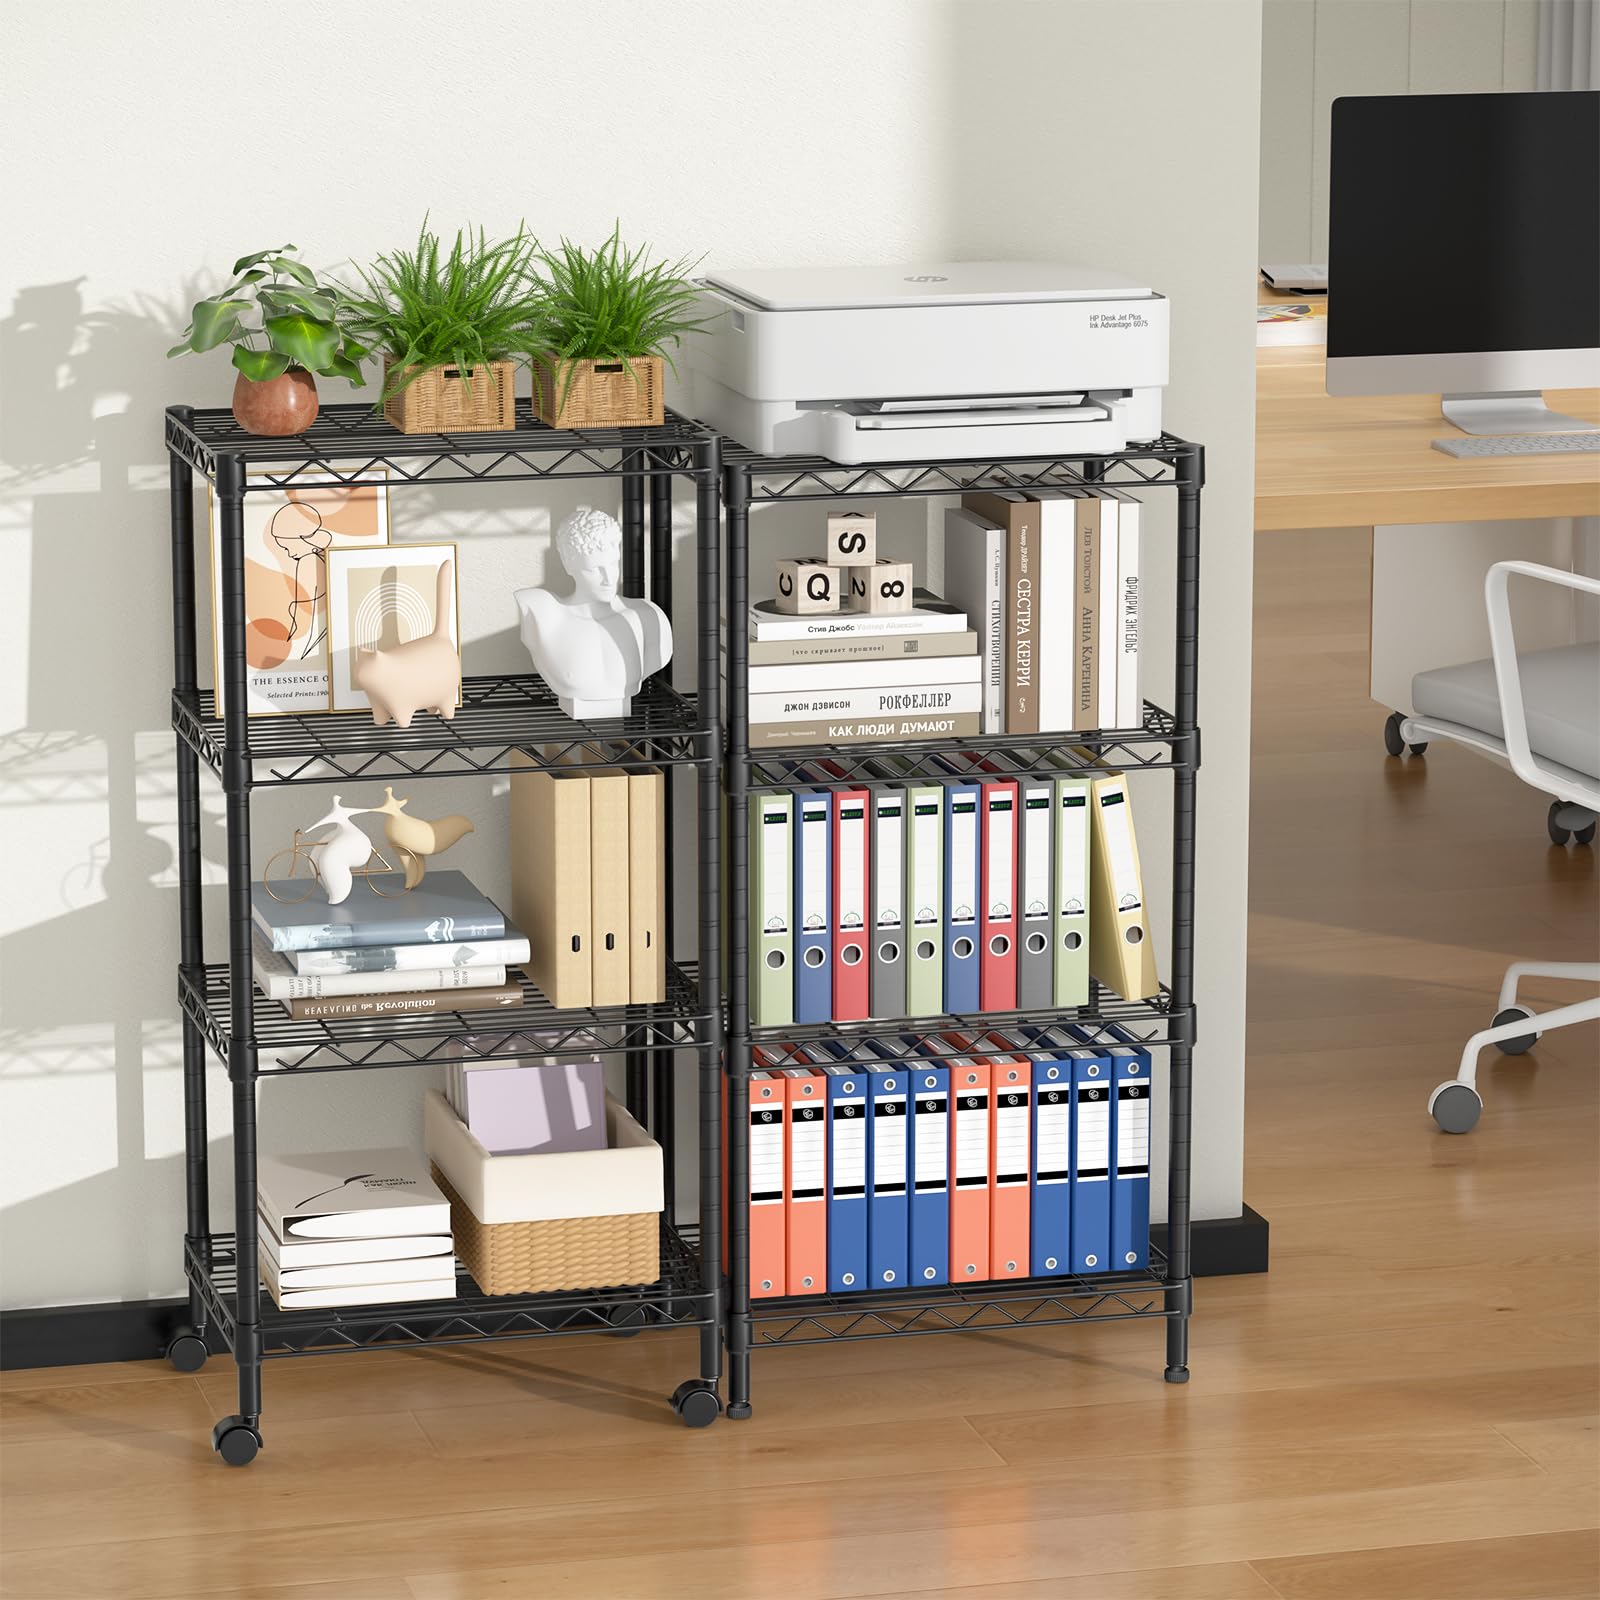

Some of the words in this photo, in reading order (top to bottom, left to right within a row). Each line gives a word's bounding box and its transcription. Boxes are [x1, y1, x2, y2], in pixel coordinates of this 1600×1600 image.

[1100, 321, 1131, 329] Advantage
[1133, 319, 1149, 327] 6075
[838, 532, 866, 554] S
[1084, 527, 1093, 546] ЛЕВ
[806, 572, 831, 602] Q
[880, 580, 905, 599] 8
[1125, 576, 1139, 616] ФРИДРИХ
[1017, 578, 1032, 635] СЕСТРА
[807, 625, 827, 633] Стив
[828, 624, 855, 633] Джобс
[1082, 607, 1093, 644] АННА
[1124, 618, 1138, 654] ЭНГЕЛЬС
[991, 600, 1001, 686] СТИХОТВОРЕНИЯ
[1017, 639, 1032, 687] КЕРРИ
[253, 677, 273, 686] THE
[276, 675, 319, 685] ESSENCE
[267, 691, 293, 699] Selected
[784, 702, 809, 712] ДЖОН
[812, 700, 851, 711] ДЭВИСОН
[879, 692, 952, 710] РОКФЕЛЛЕР
[828, 724, 853, 737] КАК
[856, 722, 895, 737] ЛЮДИ
[900, 720, 955, 735] ДУМАЮТ
